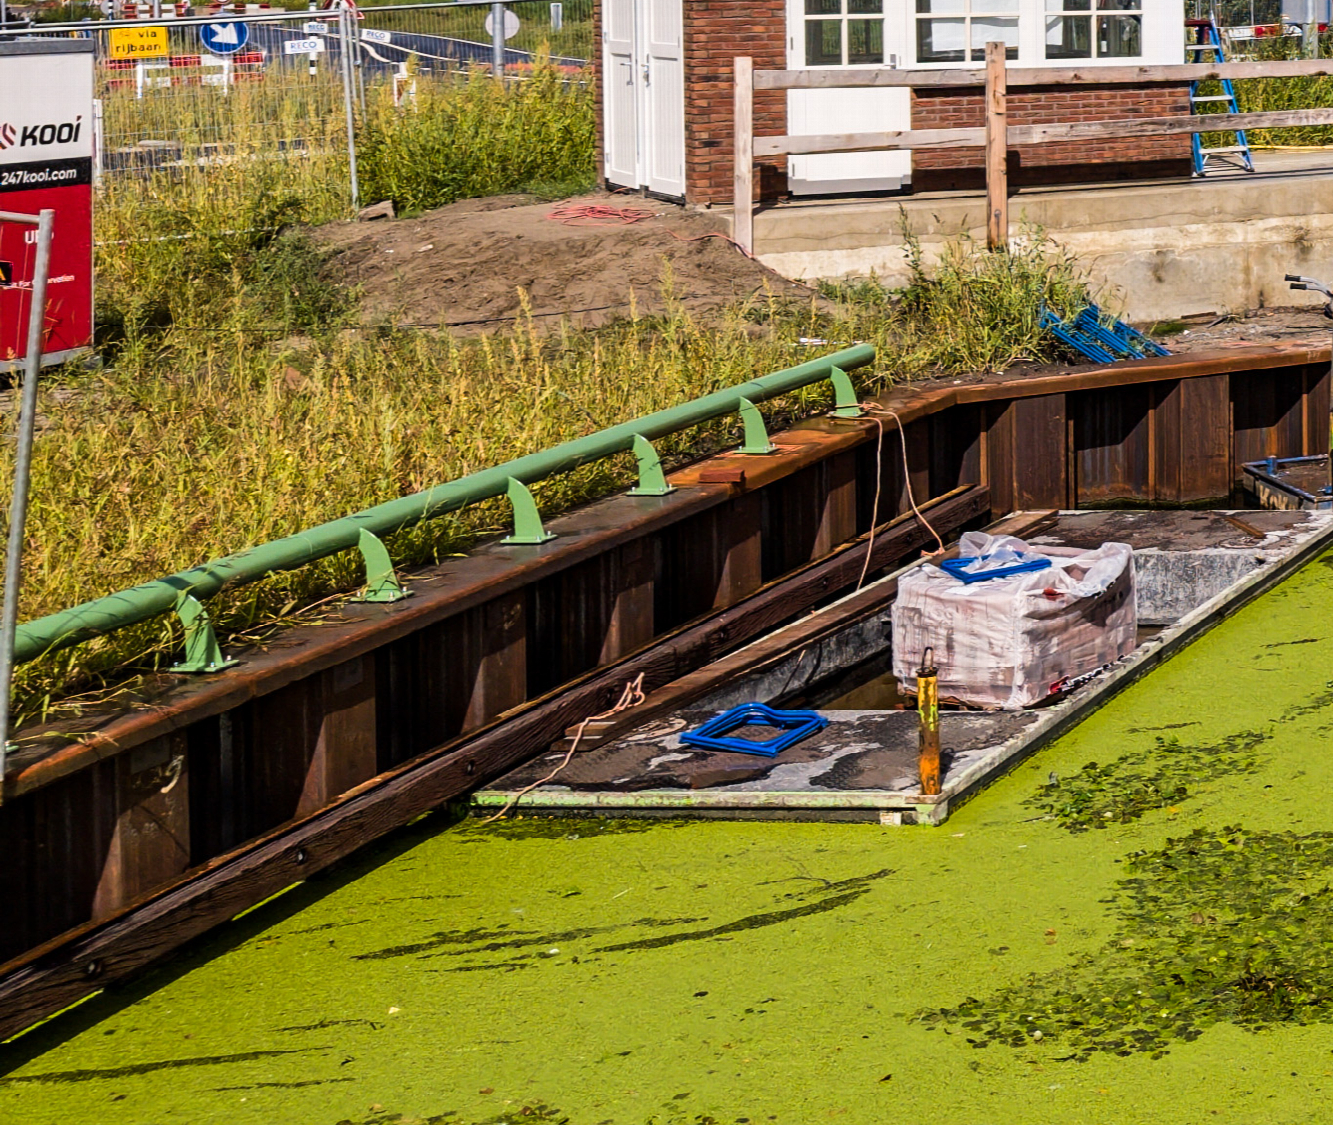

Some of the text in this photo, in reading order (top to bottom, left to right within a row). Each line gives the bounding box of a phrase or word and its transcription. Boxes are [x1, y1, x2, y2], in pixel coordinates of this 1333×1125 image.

[138, 30, 157, 38] via
[115, 43, 161, 54] rijbaan
[290, 41, 317, 49] RECO
